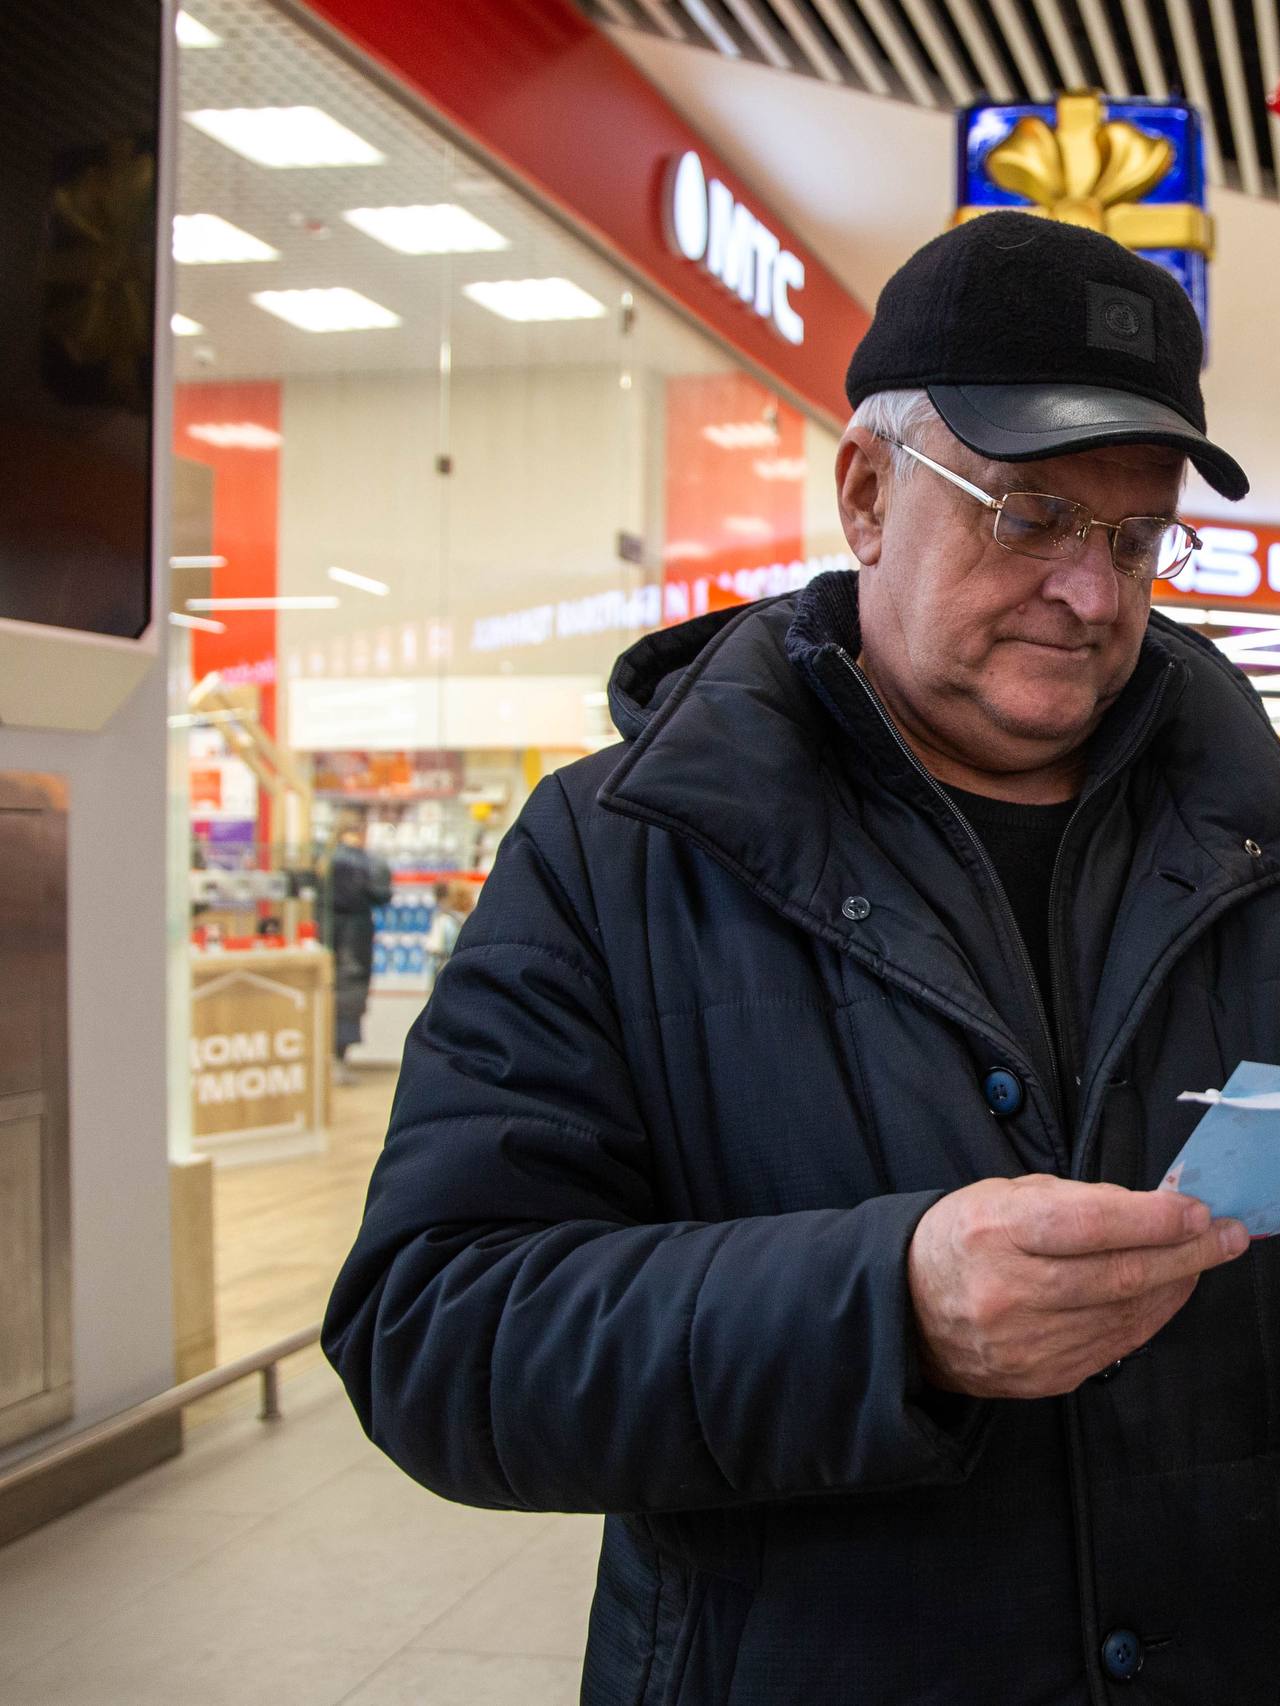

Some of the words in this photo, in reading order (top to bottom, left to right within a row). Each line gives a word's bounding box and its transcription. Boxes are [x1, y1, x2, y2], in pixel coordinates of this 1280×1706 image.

[707, 178, 805, 345] МТС
[274, 1029, 304, 1060] С
[193, 1064, 304, 1104] МОМ
